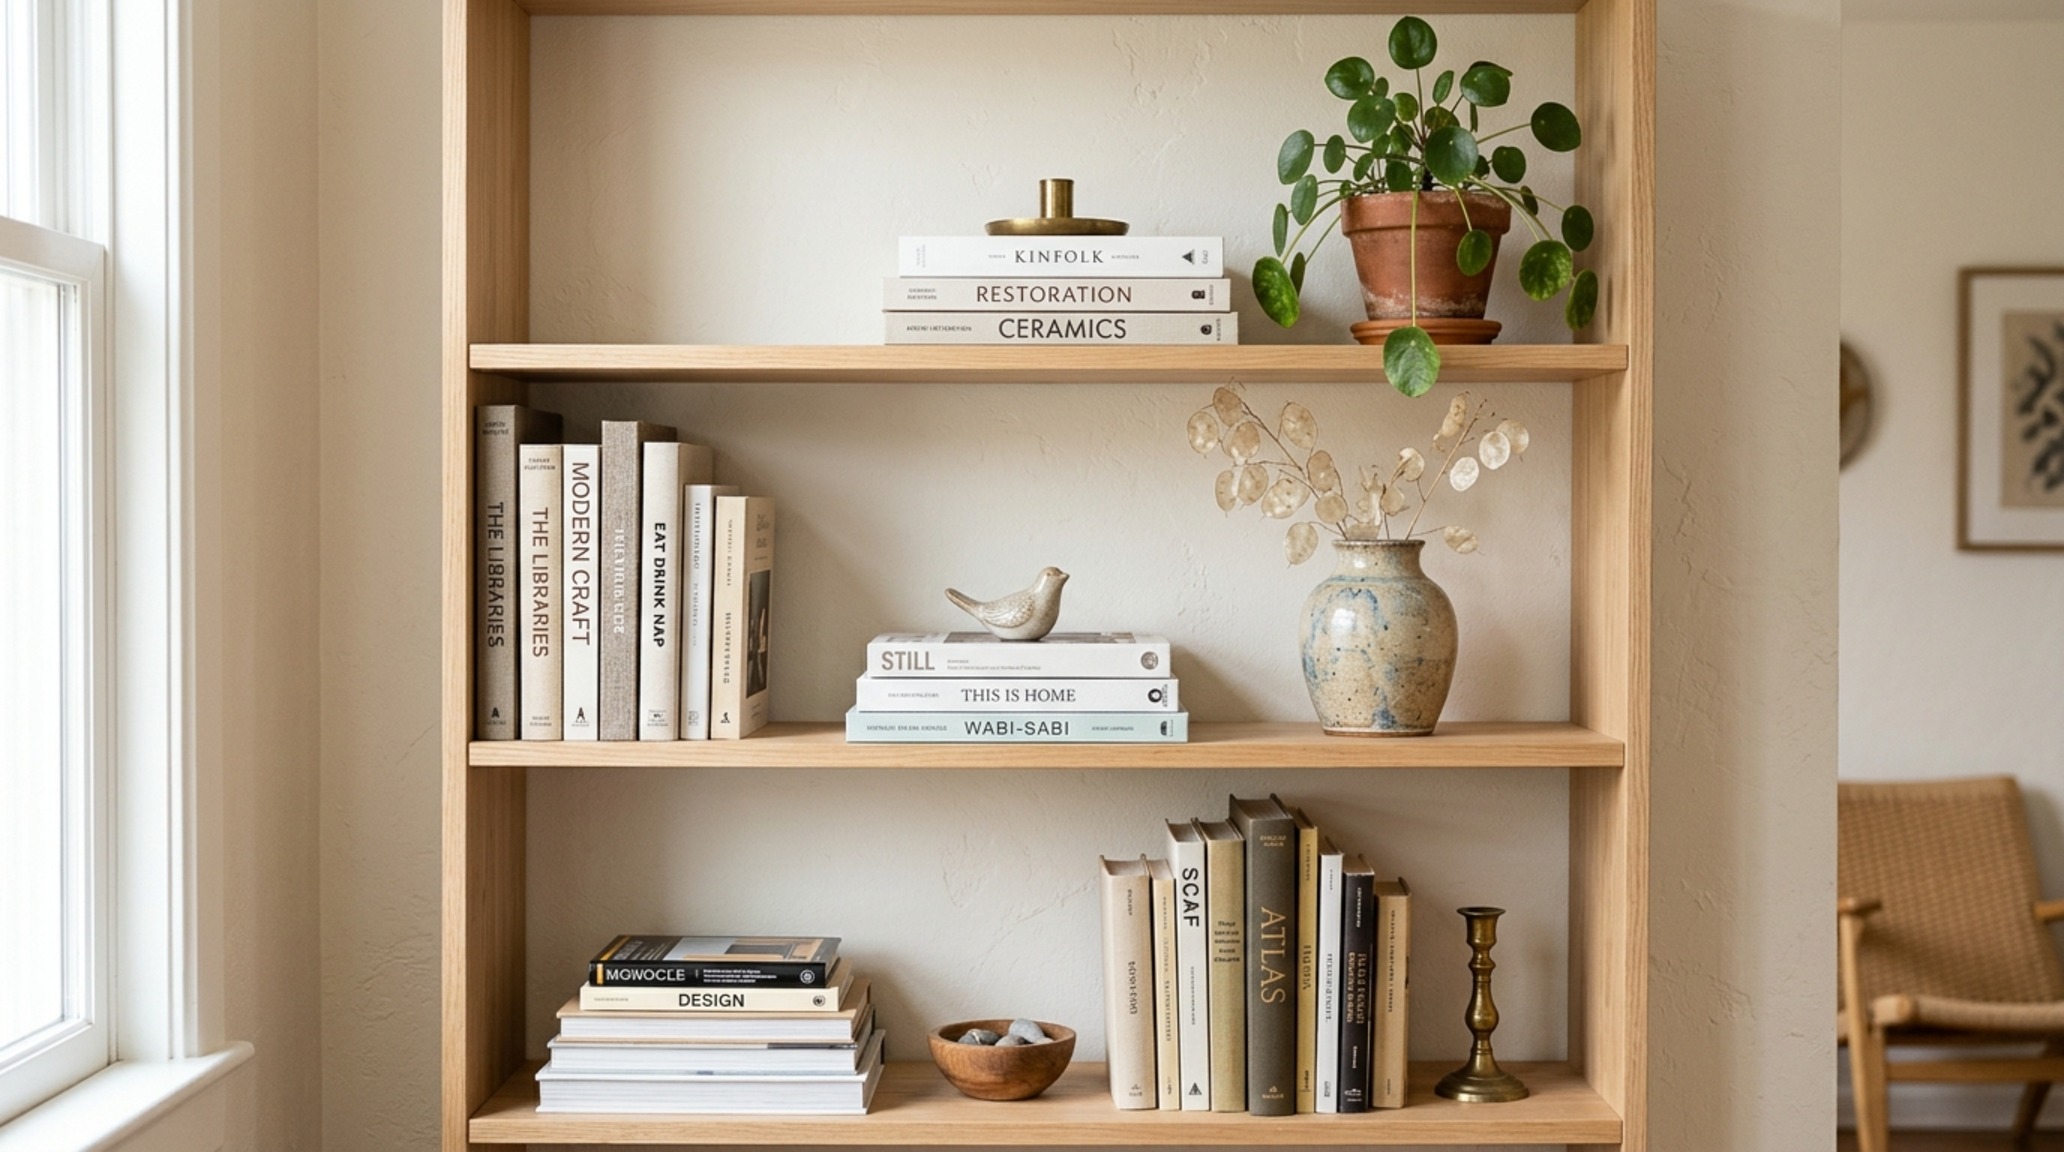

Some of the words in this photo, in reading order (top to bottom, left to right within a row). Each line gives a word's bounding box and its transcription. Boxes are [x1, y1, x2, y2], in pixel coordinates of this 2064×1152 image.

[1015, 250, 1104, 264] KINFOLK
[977, 286, 1132, 304] RESTORATION
[999, 317, 1127, 339] CERAMICS
[487, 502, 504, 540] THE
[532, 507, 549, 547] THE
[572, 462, 591, 561] MODERN
[654, 522, 667, 553] EAT
[487, 547, 505, 648] LIBRARIES
[654, 557, 666, 609] DRINK
[532, 554, 550, 657] LIBRARIES
[572, 569, 591, 646] CRAFT
[653, 614, 666, 648] NAP
[881, 650, 936, 671] STILL
[960, 688, 1001, 703] THIS
[1005, 688, 1020, 703] IS
[1025, 688, 1077, 703] HOME
[964, 721, 1070, 736] WABI-SABI
[1182, 867, 1200, 928] SCAF
[1260, 906, 1286, 1003] ATLAS
[678, 993, 745, 1008] DESIGN
